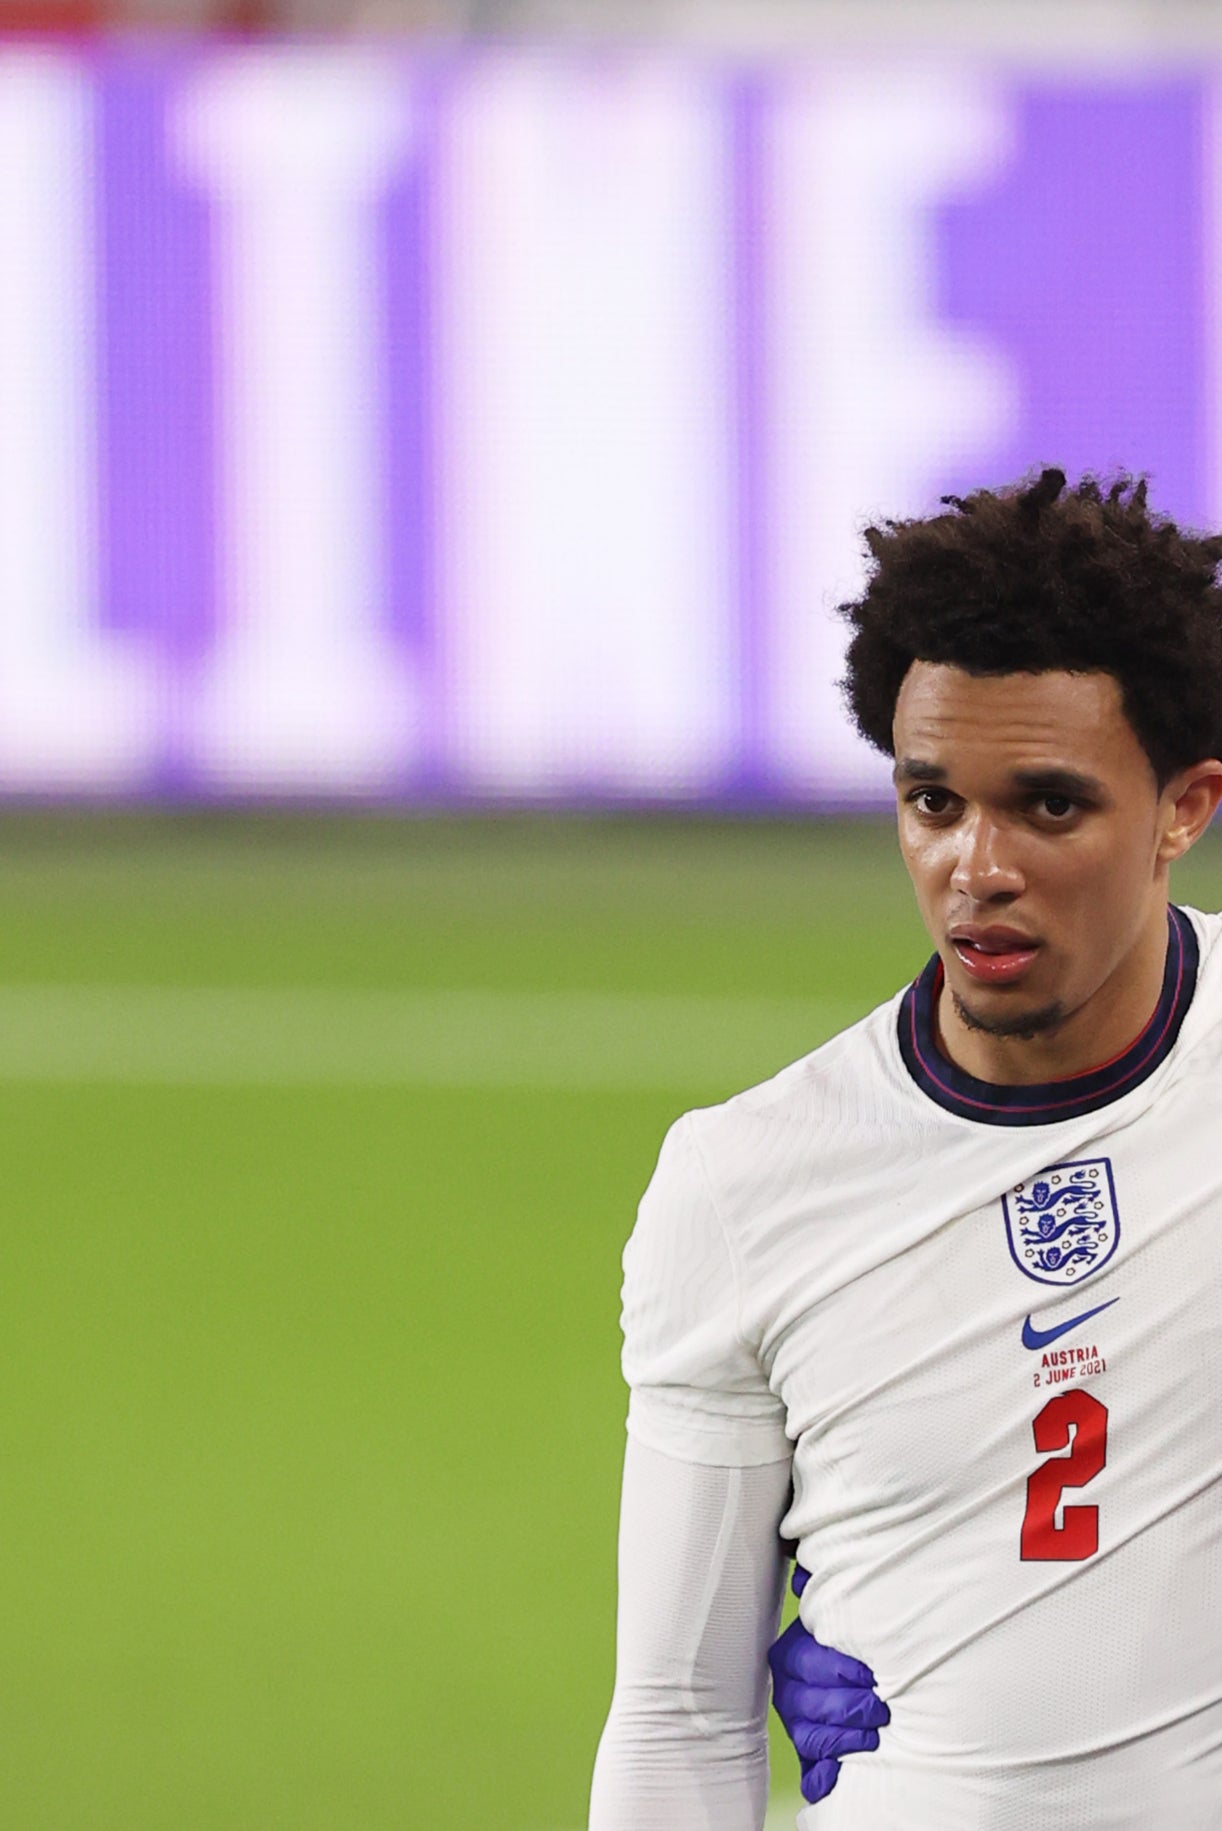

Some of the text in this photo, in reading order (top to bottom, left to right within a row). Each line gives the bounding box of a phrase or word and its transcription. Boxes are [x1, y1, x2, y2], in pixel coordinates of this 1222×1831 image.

[1042, 1345, 1098, 1368] AUSTRIA
[1033, 1358, 1107, 1387] 2 JUNE 2021
[1020, 1389, 1109, 1561] 2
